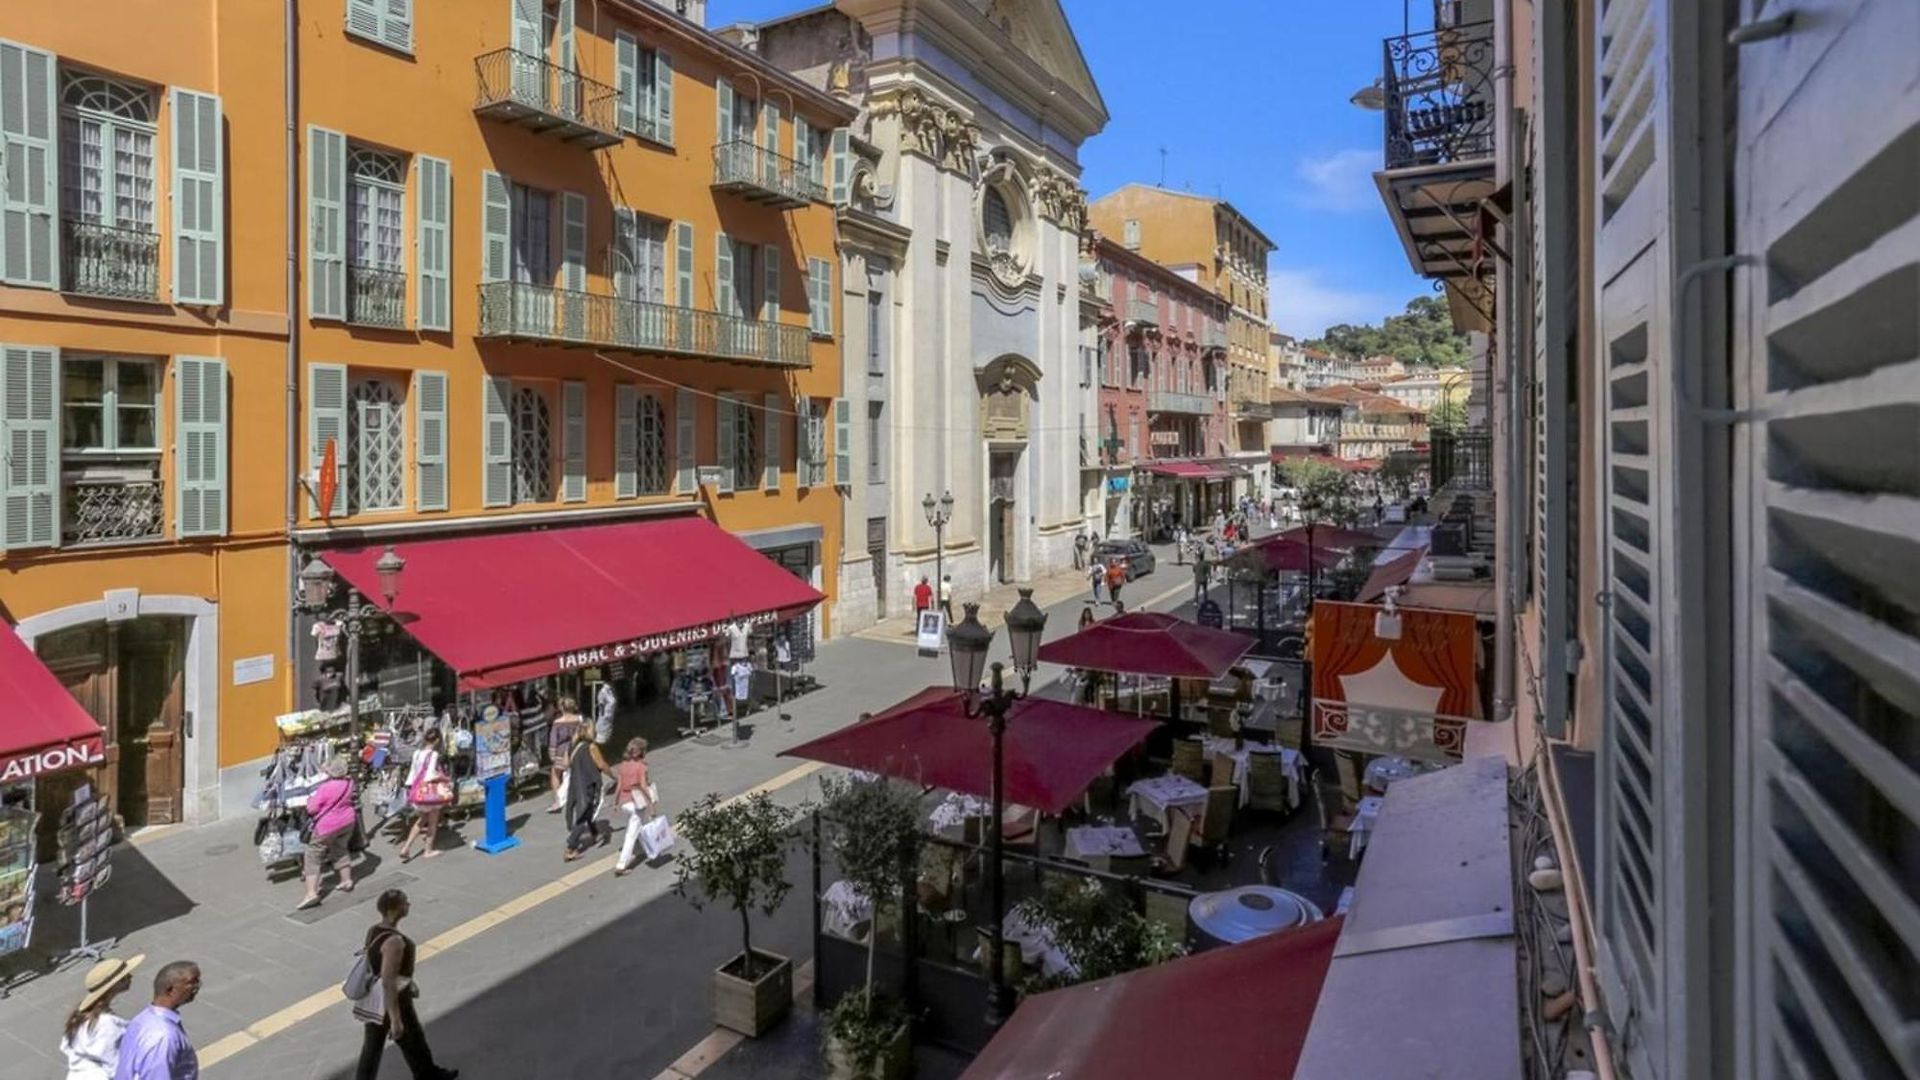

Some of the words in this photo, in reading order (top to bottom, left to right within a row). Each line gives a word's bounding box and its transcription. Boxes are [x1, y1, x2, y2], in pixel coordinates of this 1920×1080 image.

[117, 602, 128, 614] 9
[558, 646, 608, 669] TABAC
[614, 644, 625, 657] &
[630, 626, 708, 655] SOUVENIRS
[0, 744, 88, 782] ATION
